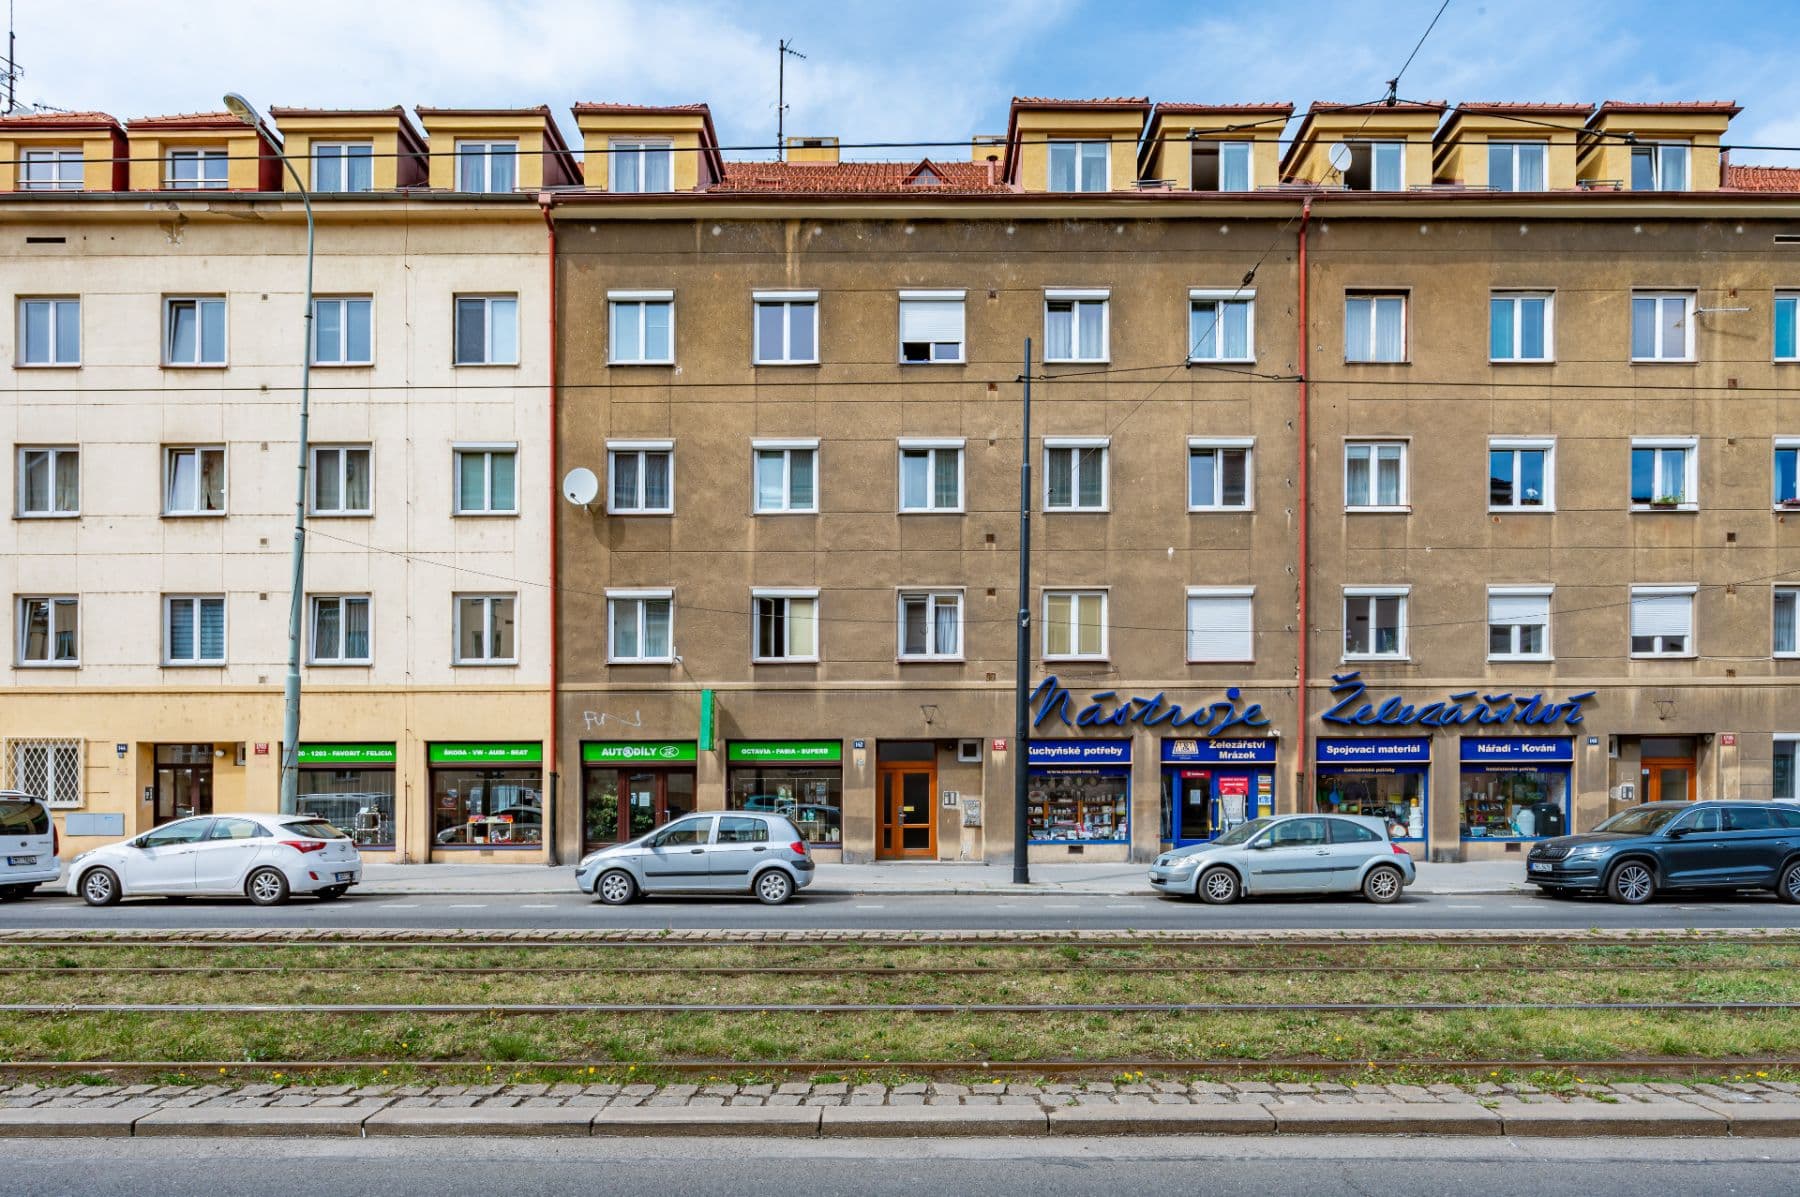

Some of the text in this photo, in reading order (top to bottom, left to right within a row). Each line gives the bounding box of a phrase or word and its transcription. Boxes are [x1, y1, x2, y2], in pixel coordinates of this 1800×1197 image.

[1322, 671, 1597, 726] Železářství
[1029, 675, 1271, 737] Nástroje
[1208, 739, 1266, 749] Železářství
[1477, 744, 1511, 753] Nářadí
[1521, 744, 1556, 753] Kování
[443, 747, 467, 756] ŠKODA
[1083, 746, 1123, 757] potřeby
[1219, 750, 1256, 759] Mrázek
[1326, 744, 1420, 755] Spojovací materiál
